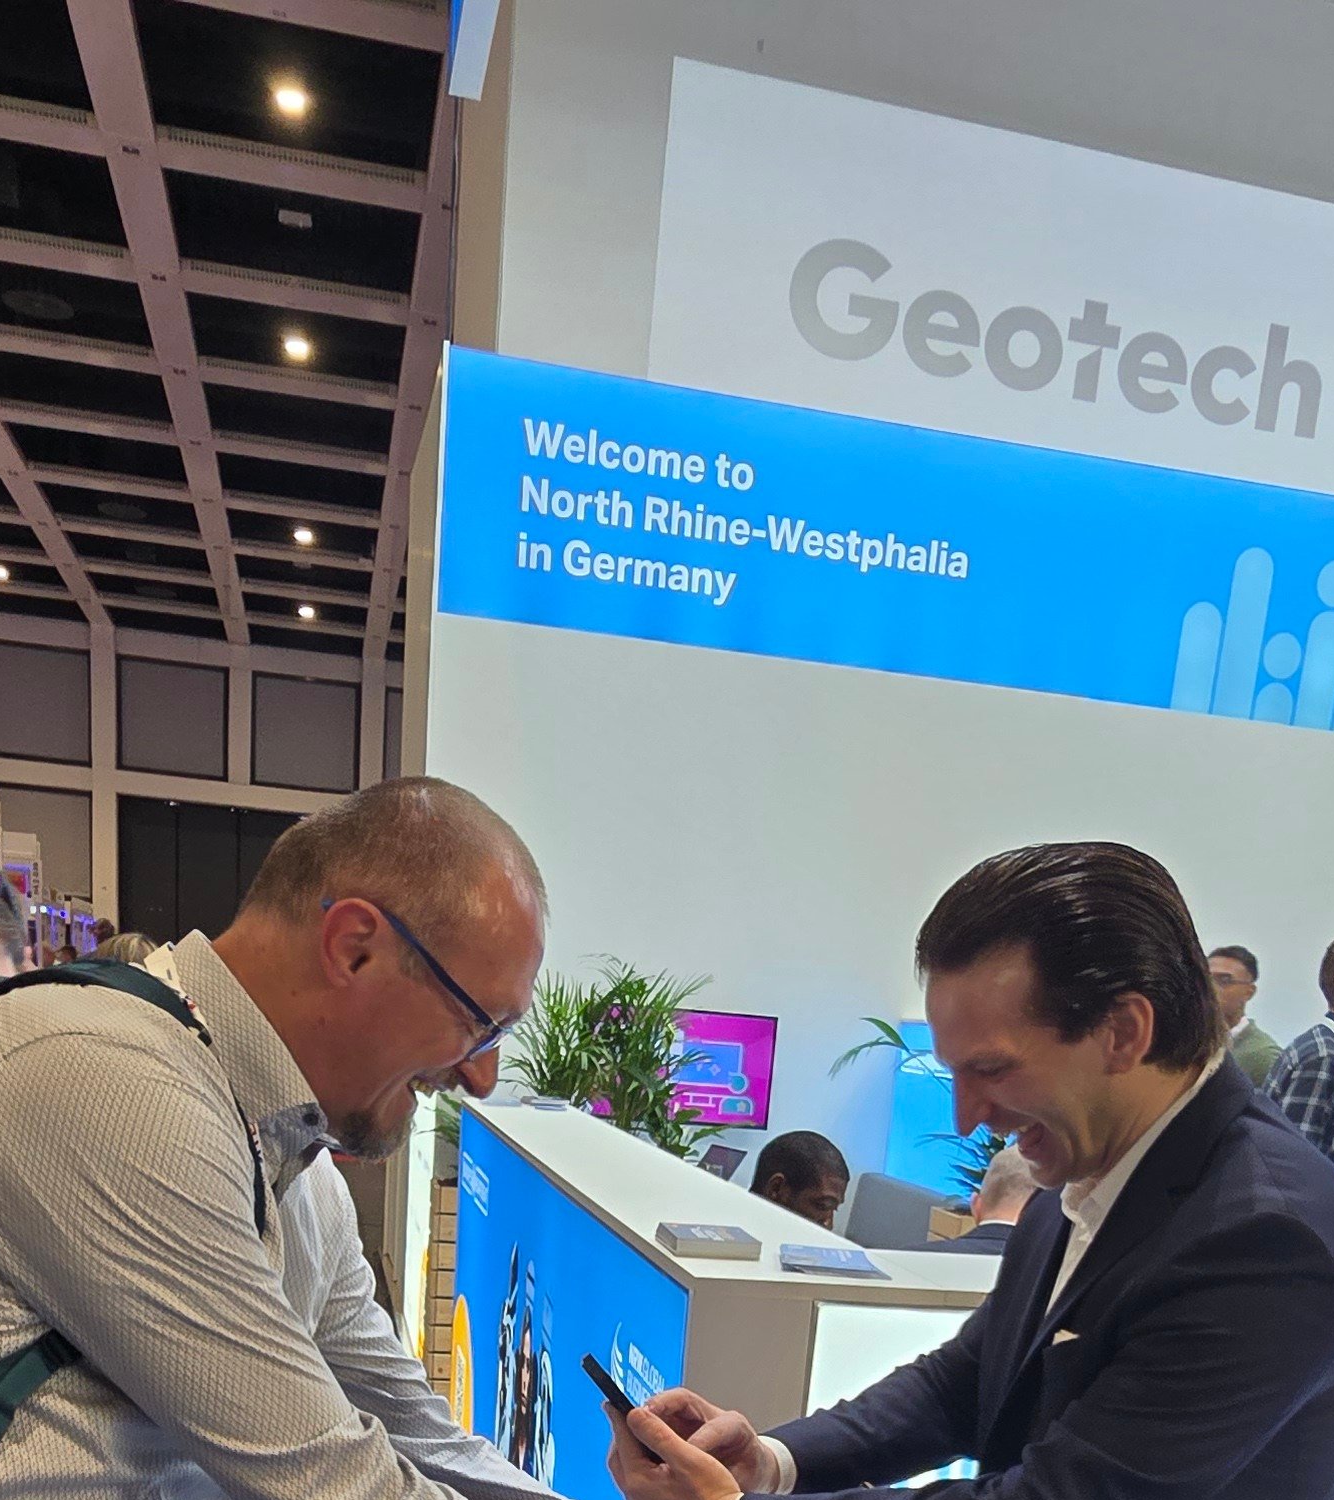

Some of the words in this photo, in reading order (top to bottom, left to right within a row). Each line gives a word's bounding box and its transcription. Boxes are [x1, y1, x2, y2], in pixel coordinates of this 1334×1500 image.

[789, 237, 1323, 440] Geotech
[523, 418, 706, 485] Welcome
[714, 452, 756, 491] to
[517, 533, 552, 573] in
[562, 539, 737, 607] Germany
[520, 475, 634, 531] North
[644, 495, 970, 580] Rhine-Westphalia
